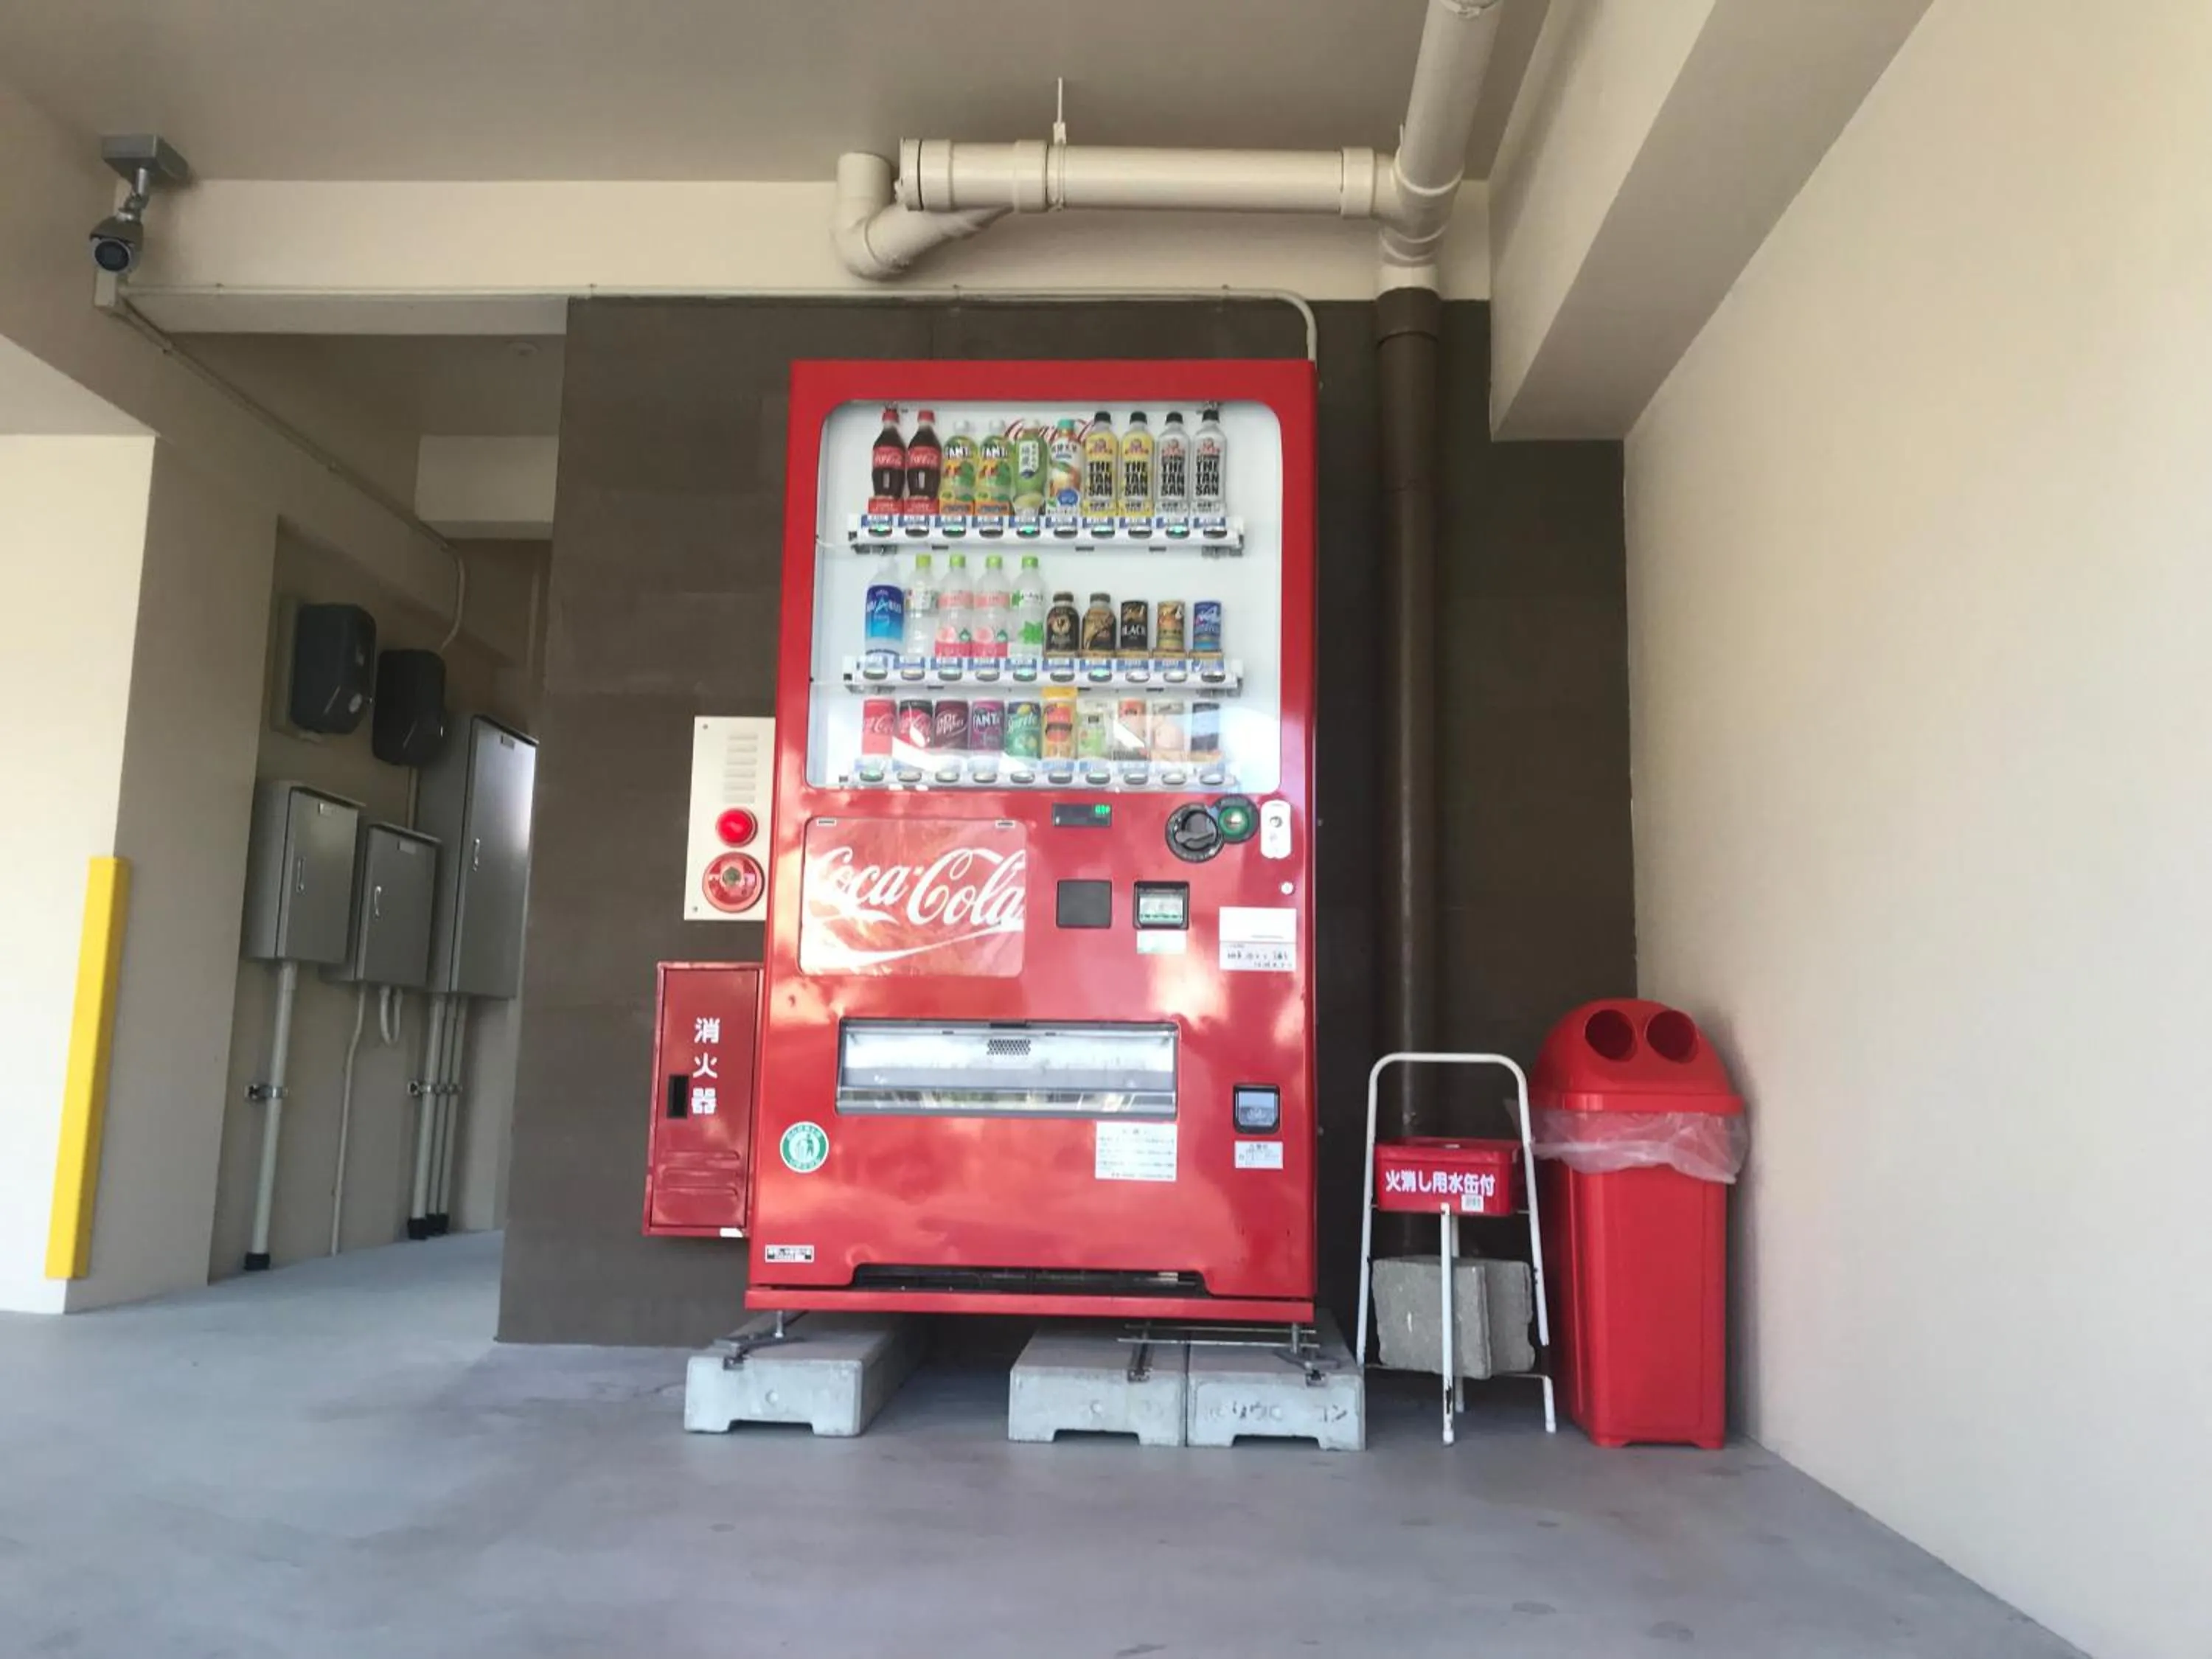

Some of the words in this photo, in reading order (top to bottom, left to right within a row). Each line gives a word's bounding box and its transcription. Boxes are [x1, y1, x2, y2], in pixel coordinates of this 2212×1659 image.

[808, 846, 1026, 928] Coca-Cola
[691, 1017, 720, 1114] 消火器
